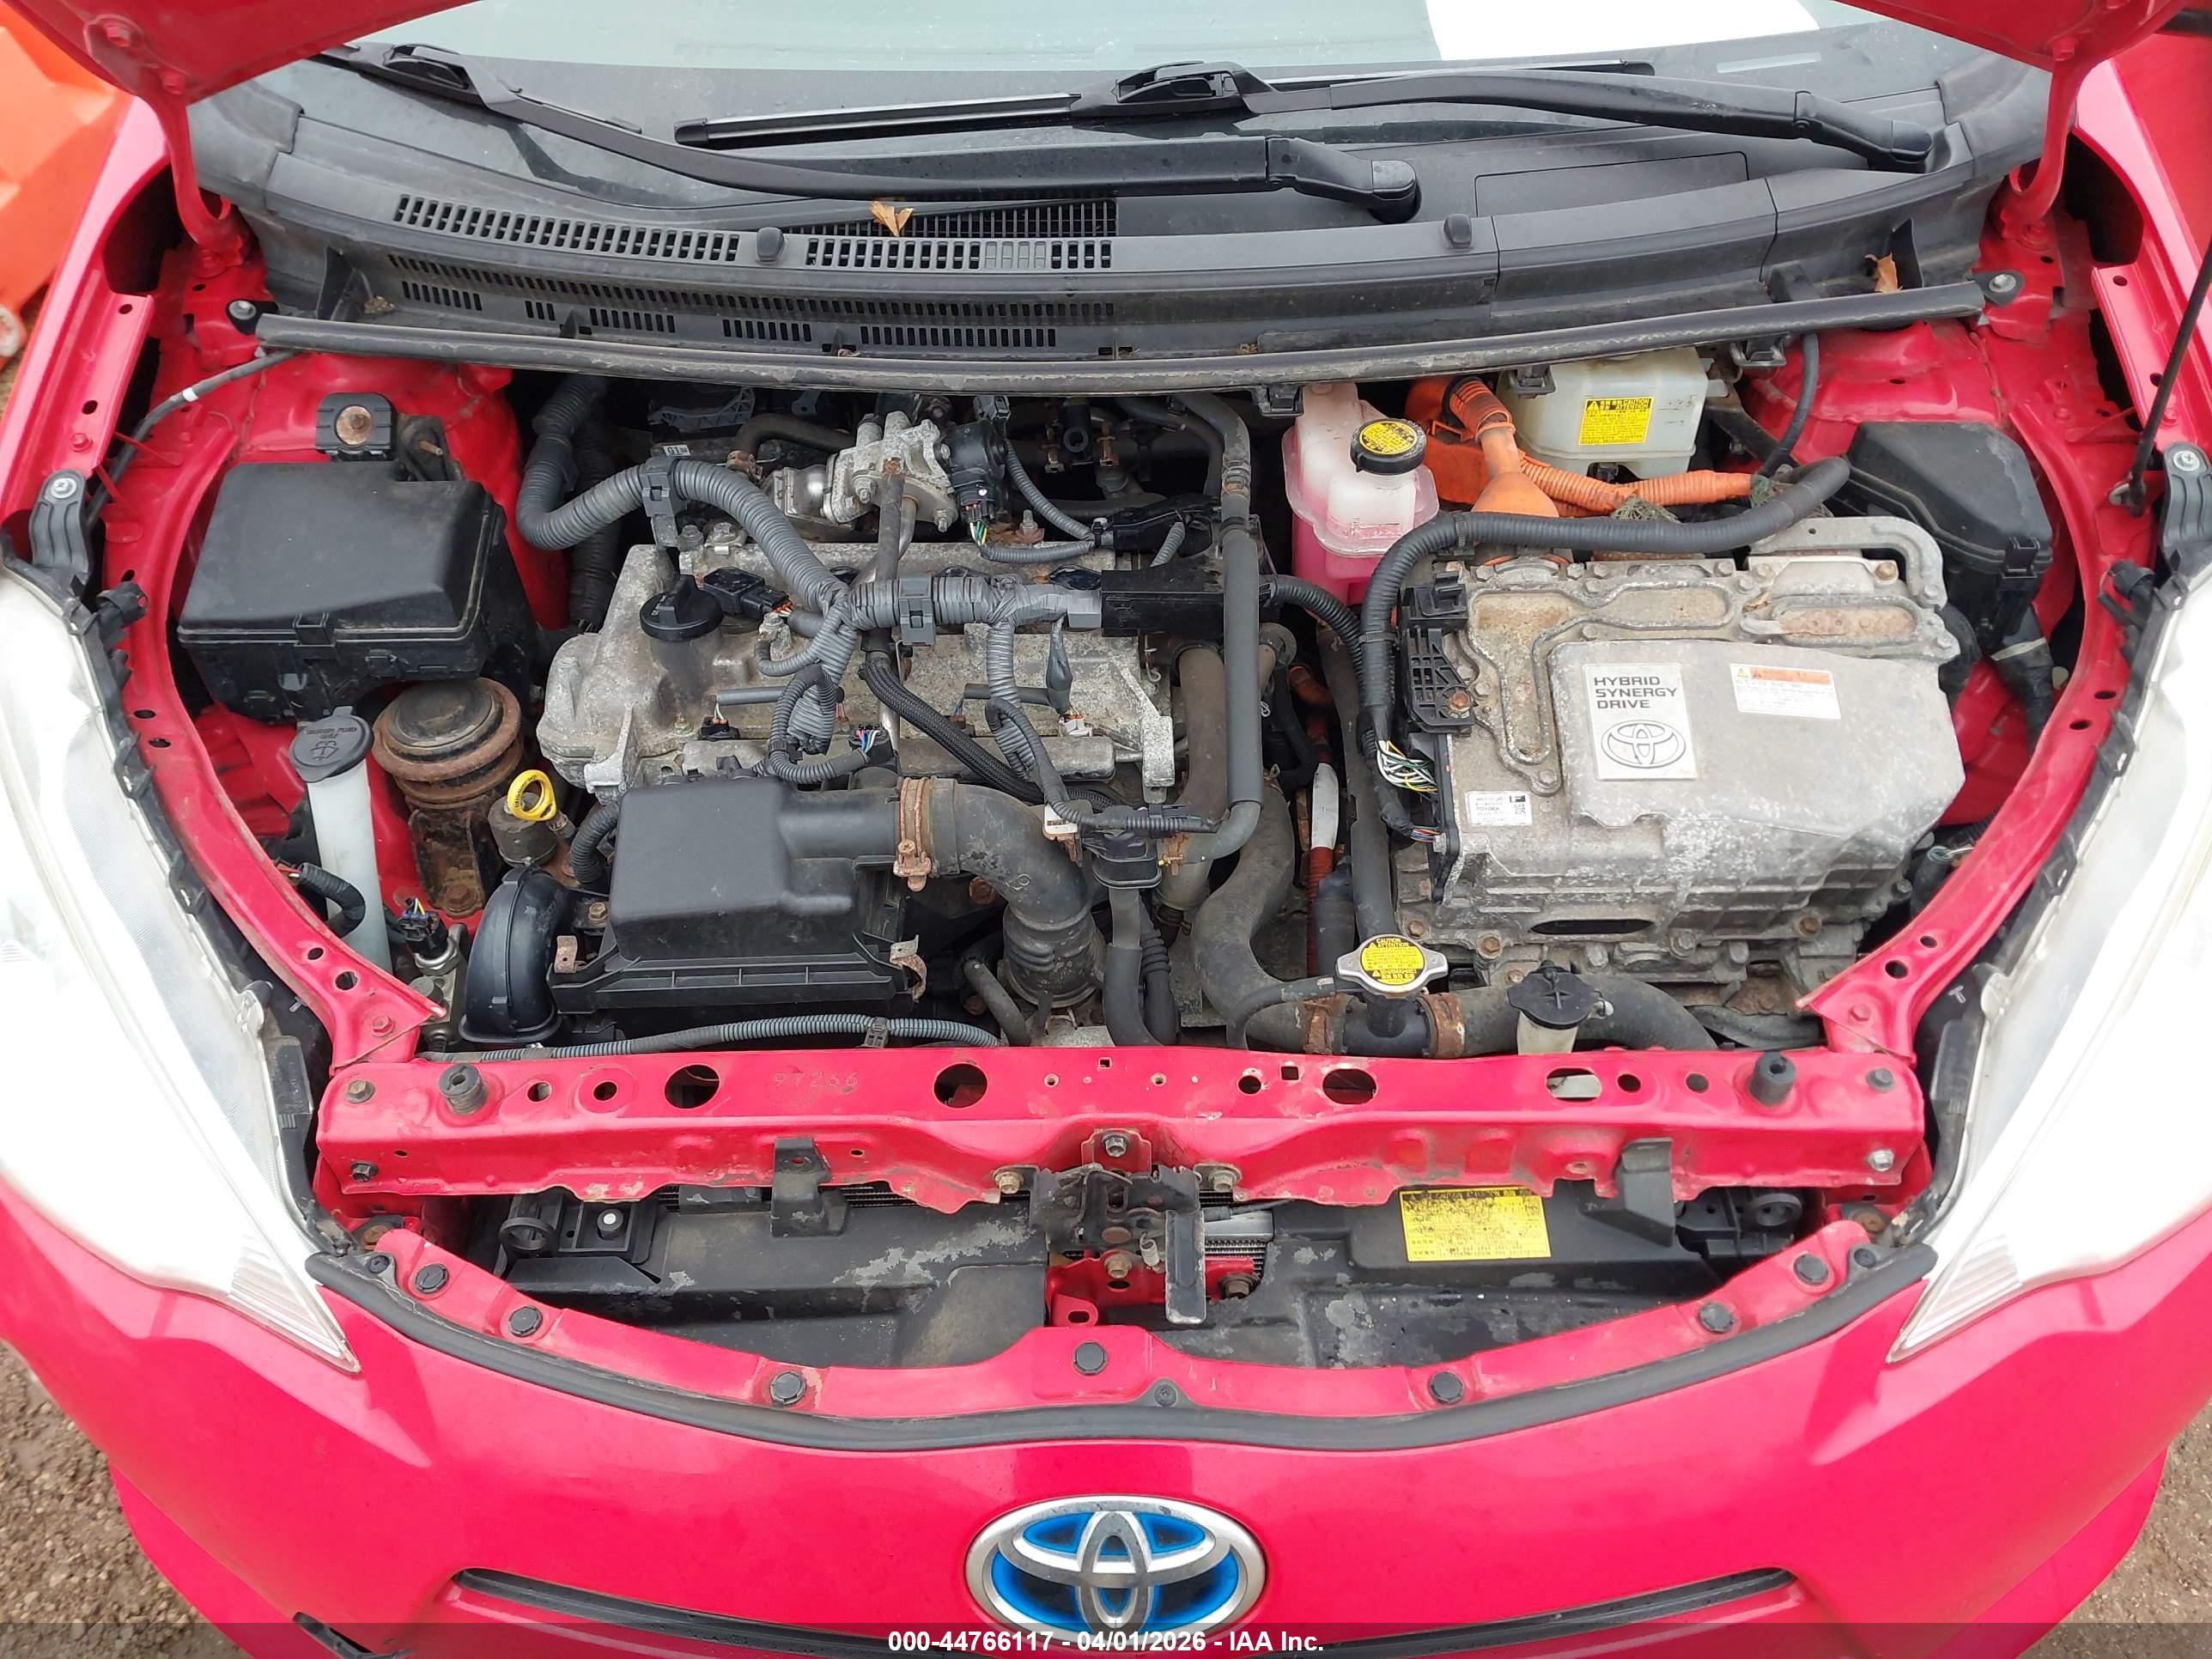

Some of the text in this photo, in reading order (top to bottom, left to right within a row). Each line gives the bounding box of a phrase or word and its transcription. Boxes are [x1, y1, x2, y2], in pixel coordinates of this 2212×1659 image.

[1594, 676, 1661, 686] HYBRID
[1595, 687, 1677, 698] SYNERGY
[1597, 699, 1650, 709] DRIVE
